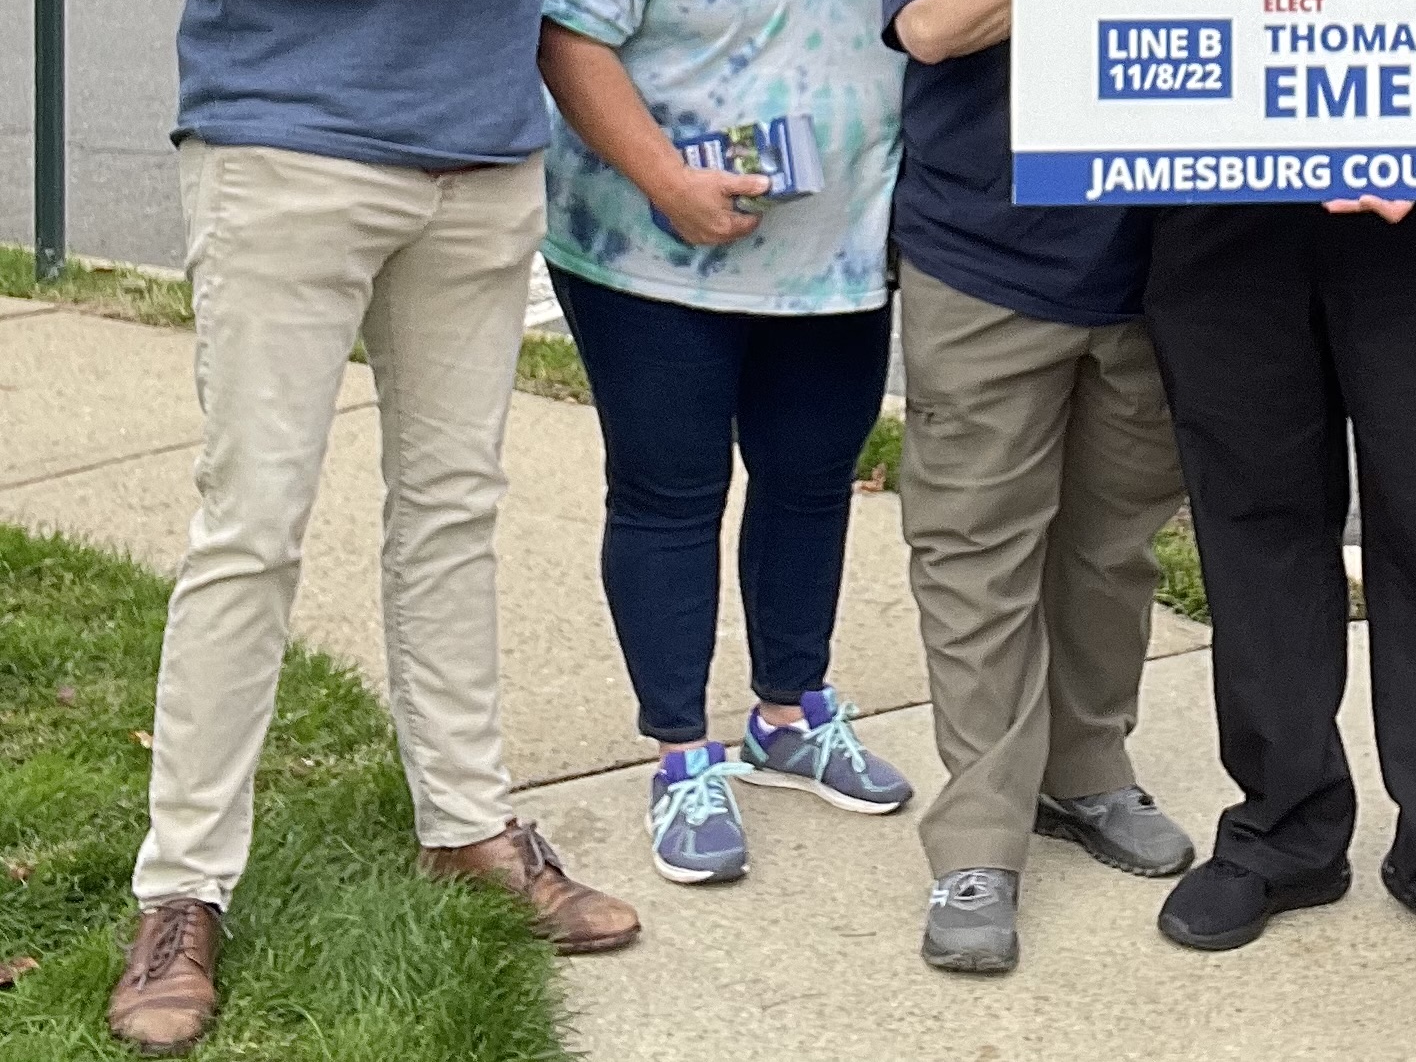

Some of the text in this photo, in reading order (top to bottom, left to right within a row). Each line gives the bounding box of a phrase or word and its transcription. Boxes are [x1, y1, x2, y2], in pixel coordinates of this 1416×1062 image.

[1108, 28, 1222, 59] LINE B
[1109, 63, 1223, 91] 11/8/22
[1086, 155, 1331, 200] JAMESBURG
